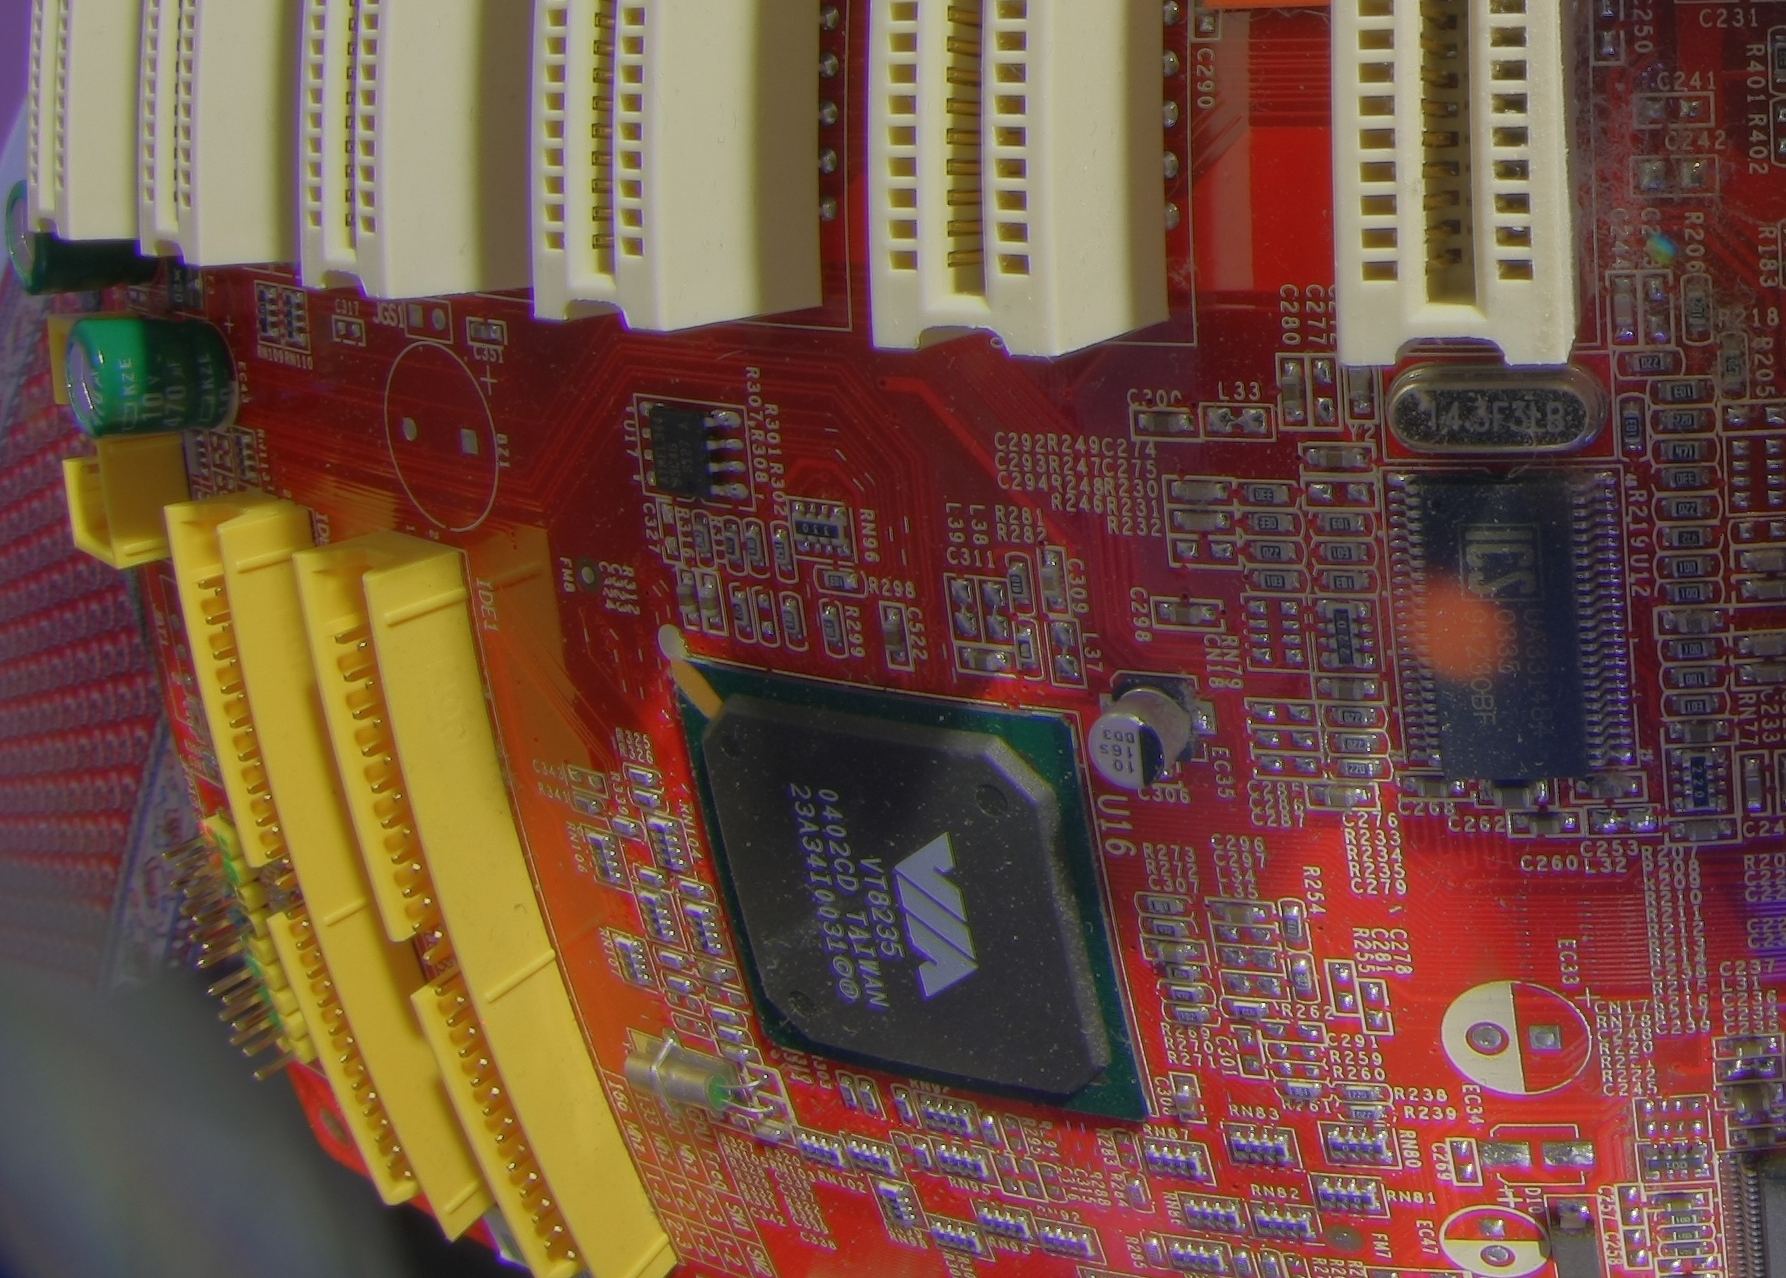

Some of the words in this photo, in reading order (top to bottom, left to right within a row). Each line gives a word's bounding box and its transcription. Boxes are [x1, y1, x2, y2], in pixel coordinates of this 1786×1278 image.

[1699, 7, 1760, 29] C231
[1656, 71, 1718, 92] C241
[1745, 43, 1767, 105] R401
[1747, 112, 1770, 176] R402
[1683, 211, 1706, 274] R206
[1757, 225, 1780, 289] R183
[118, 357, 139, 397] KZE
[1217, 380, 1262, 402] L33
[141, 391, 165, 421] 10
[994, 430, 1047, 454] C292
[1047, 432, 1101, 455] R249
[994, 451, 1048, 473] C293
[1049, 454, 1102, 476] R247
[1102, 456, 1159, 480] C275
[859, 507, 882, 565] RN96
[1107, 516, 1163, 539] R232
[1626, 487, 1650, 549] R219
[1462, 528, 1539, 598] ICS
[1629, 553, 1653, 598] U12
[476, 577, 500, 633] IDE1
[867, 575, 917, 599] R298
[844, 604, 865, 659] R299
[906, 606, 930, 662] C522
[1129, 585, 1154, 644] C298
[1080, 631, 1105, 673] L37
[1220, 634, 1246, 691] RN79
[1736, 691, 1761, 747] RN77
[1210, 745, 1238, 801] EC35
[1096, 793, 1139, 859] U16
[1447, 815, 1507, 833] C262
[1141, 841, 1198, 863] R273
[1520, 854, 1580, 873] C260
[816, 787, 862, 892] 0402CD
[845, 910, 892, 1010] TAIWAN
[859, 856, 906, 959] VT8235
[1301, 864, 1328, 916] R254
[1350, 877, 1409, 896] C279
[1351, 926, 1377, 974] R255
[1389, 927, 1415, 976] C278
[1556, 937, 1582, 986] EC33
[1718, 958, 1776, 977] C237
[1215, 1035, 1240, 1076] C301
[1228, 1104, 1281, 1122] RN83
[1392, 1085, 1450, 1103] R238
[1402, 1104, 1458, 1121] R239
[1398, 1128, 1423, 1169] RN80
[1430, 1141, 1453, 1182] C269
[1249, 1183, 1301, 1202] RN82
[1386, 1188, 1438, 1206] RN81
[725, 1199, 752, 1235] SW1
[745, 1244, 769, 1277] SW2
[1414, 1218, 1442, 1256] EC47
